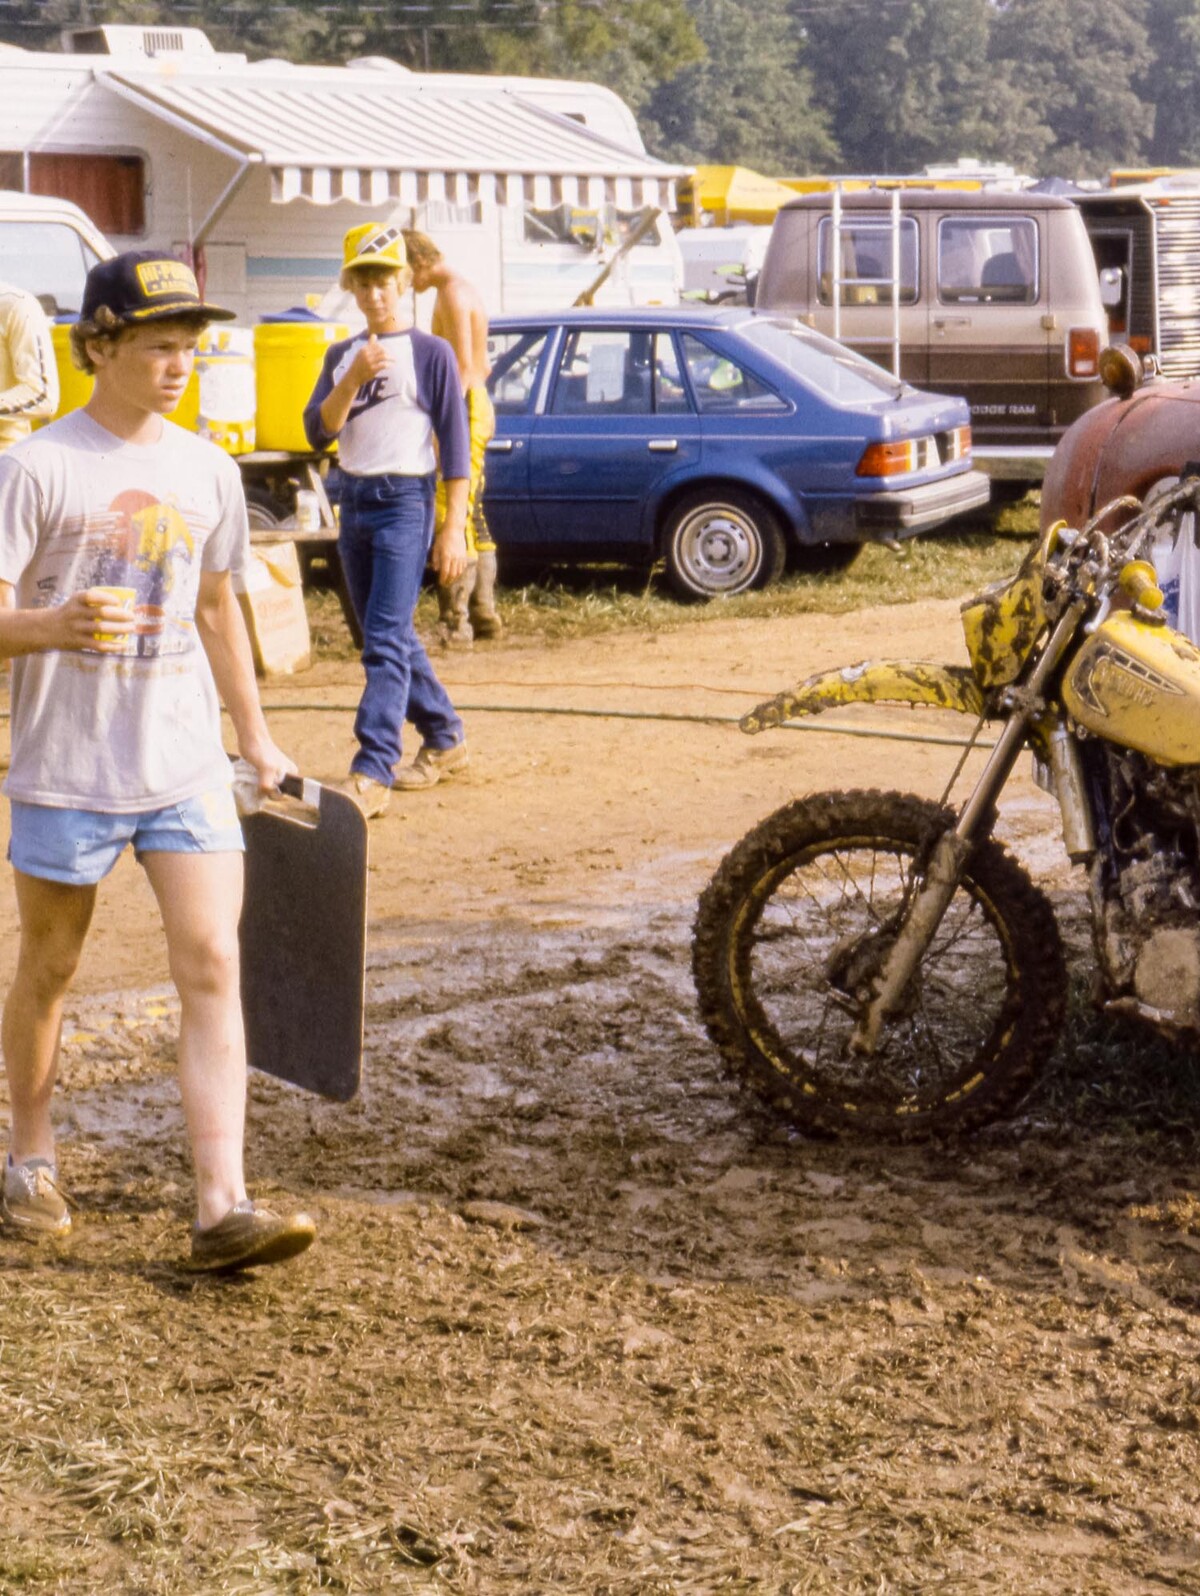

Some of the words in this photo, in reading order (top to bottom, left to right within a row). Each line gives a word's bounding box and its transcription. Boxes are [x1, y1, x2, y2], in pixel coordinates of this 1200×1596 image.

[355, 376, 389, 401] IKE
[969, 404, 1006, 415] ODGE
[1008, 404, 1036, 414] RAM
